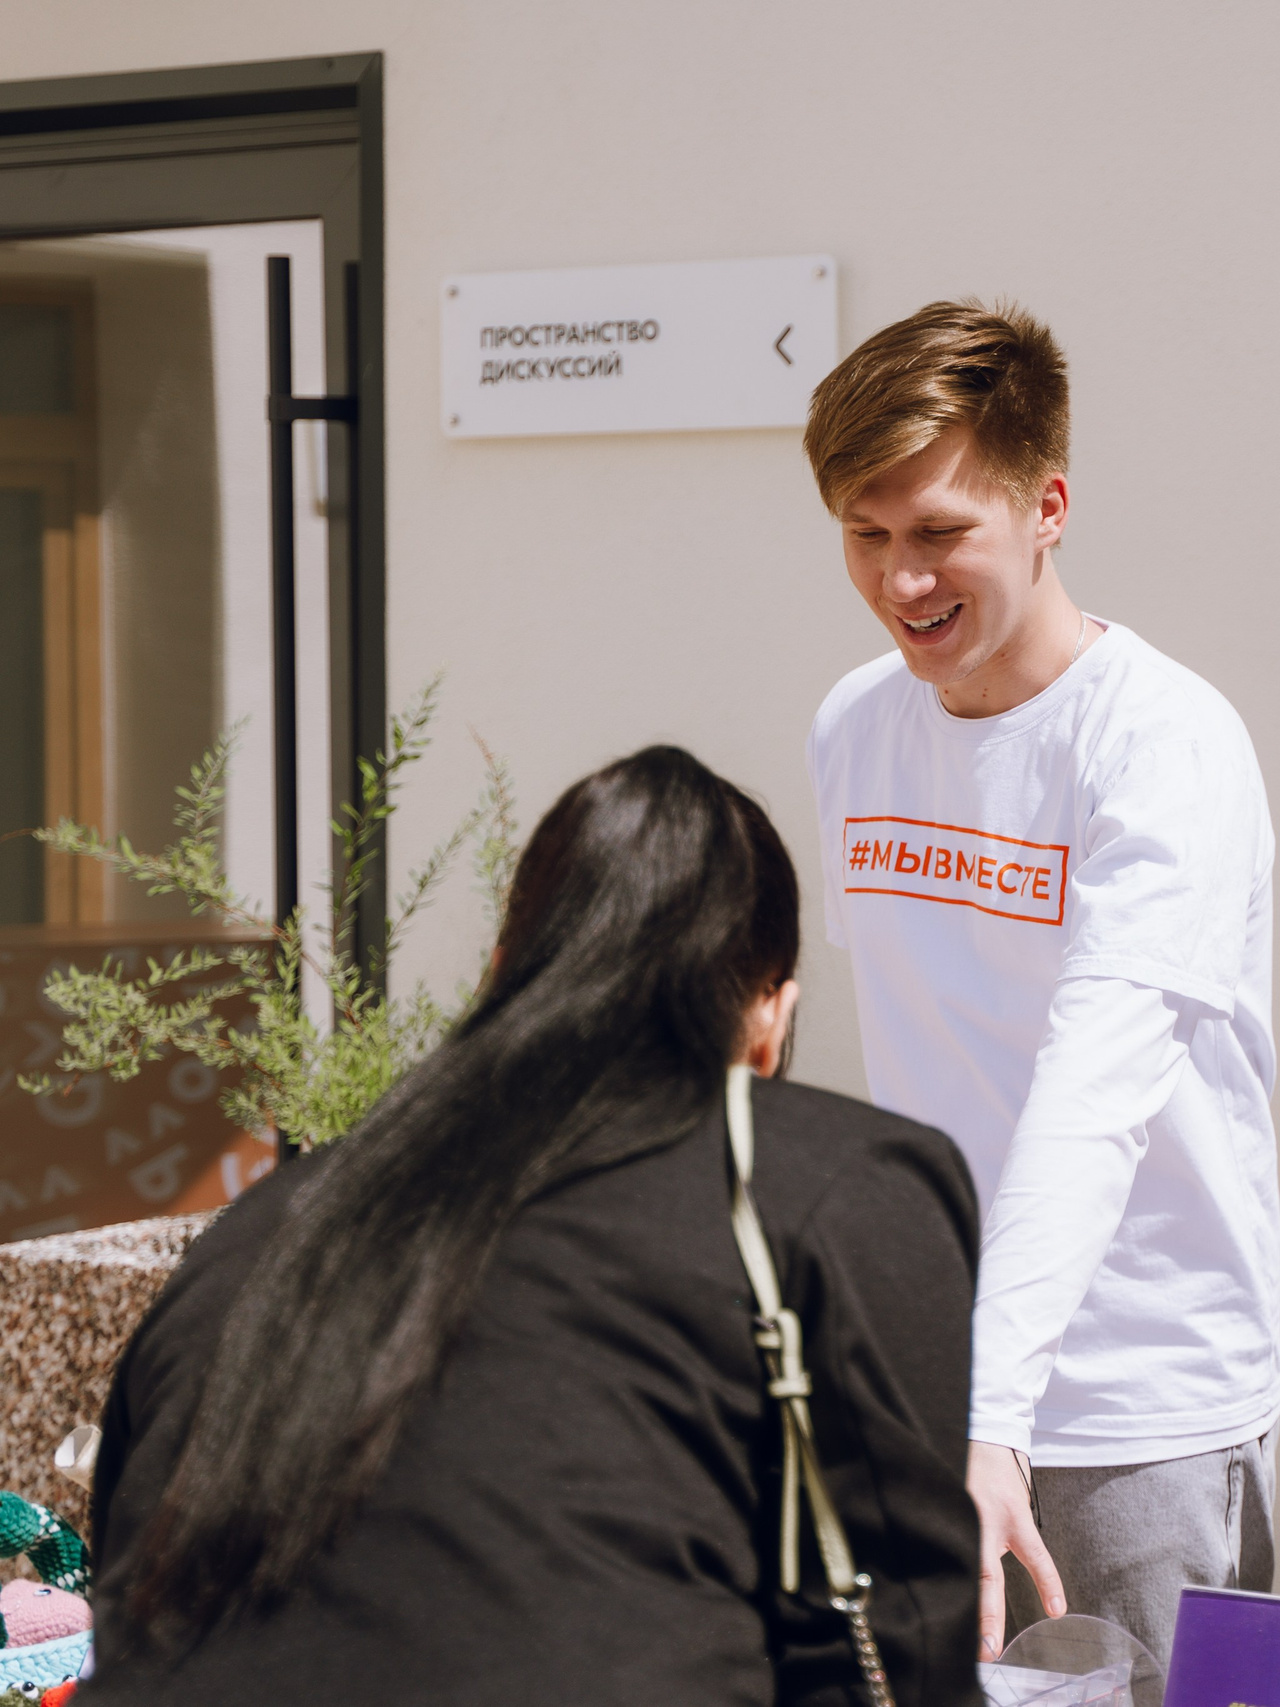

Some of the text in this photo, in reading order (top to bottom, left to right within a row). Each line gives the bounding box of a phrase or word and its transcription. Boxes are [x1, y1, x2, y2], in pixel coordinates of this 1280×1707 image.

[481, 319, 660, 348] ПРОСТРАНСТВО
[480, 351, 623, 386] ДИСКУССИЙ
[849, 839, 1051, 900] #МЫВМЕСТЕ
